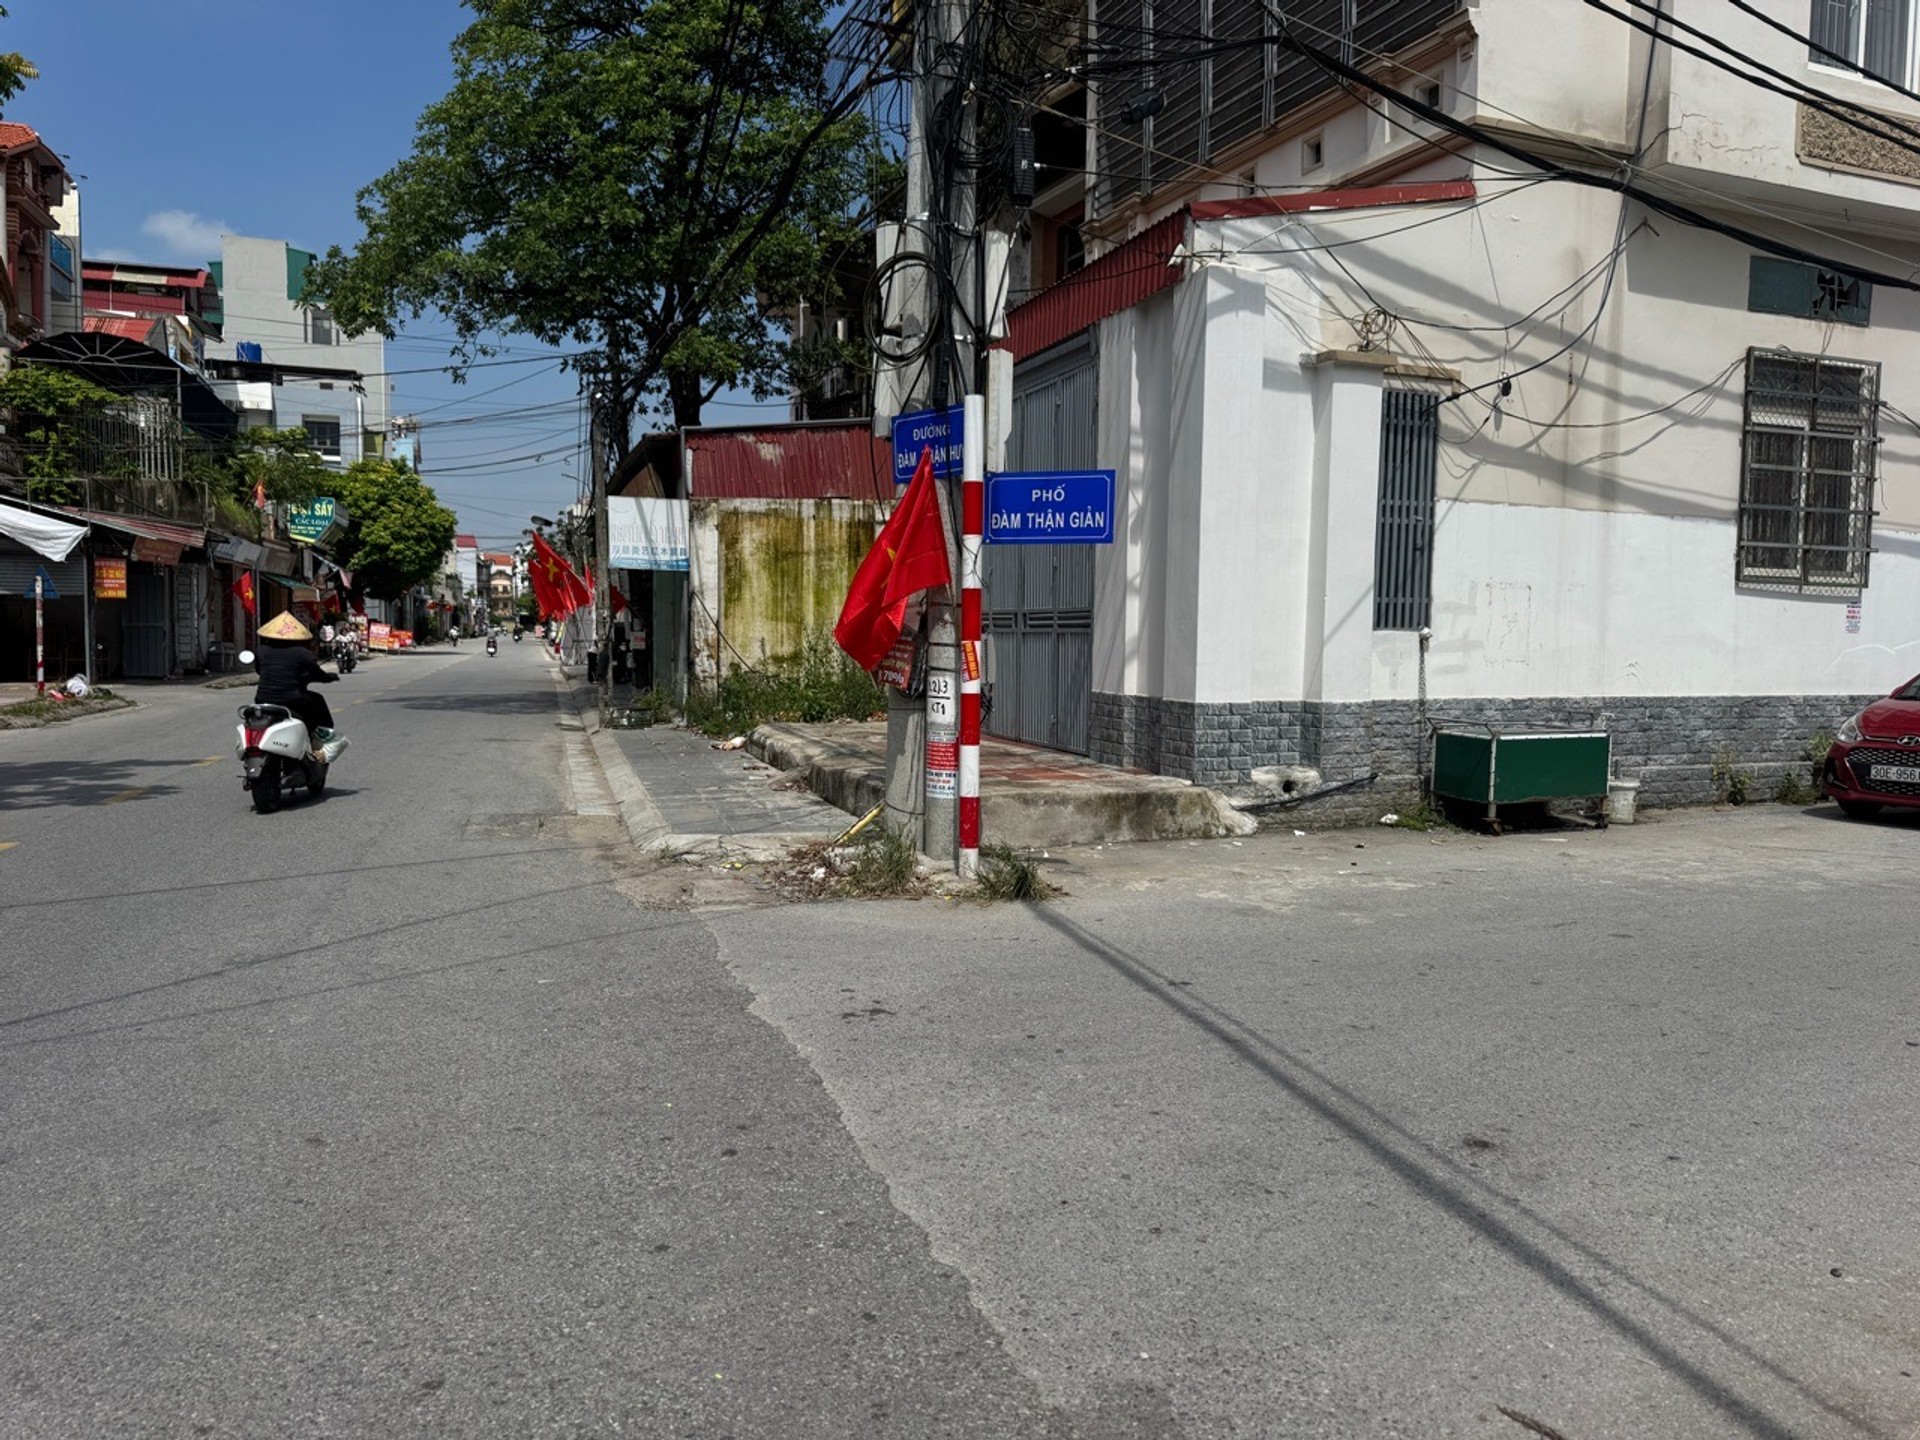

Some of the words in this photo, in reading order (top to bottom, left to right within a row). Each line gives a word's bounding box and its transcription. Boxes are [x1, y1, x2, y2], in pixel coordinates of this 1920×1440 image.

[913, 423, 951, 441] ĐƯỜNG
[897, 448, 917, 469] ĐÀM
[921, 444, 947, 468] HẬN
[1031, 483, 1066, 502] PHỐ
[990, 508, 1021, 530] ĐÀM
[1026, 508, 1065, 533] THẬN
[1069, 505, 1105, 529] GIẢN
[1872, 766, 1920, 782] 30E-956.
